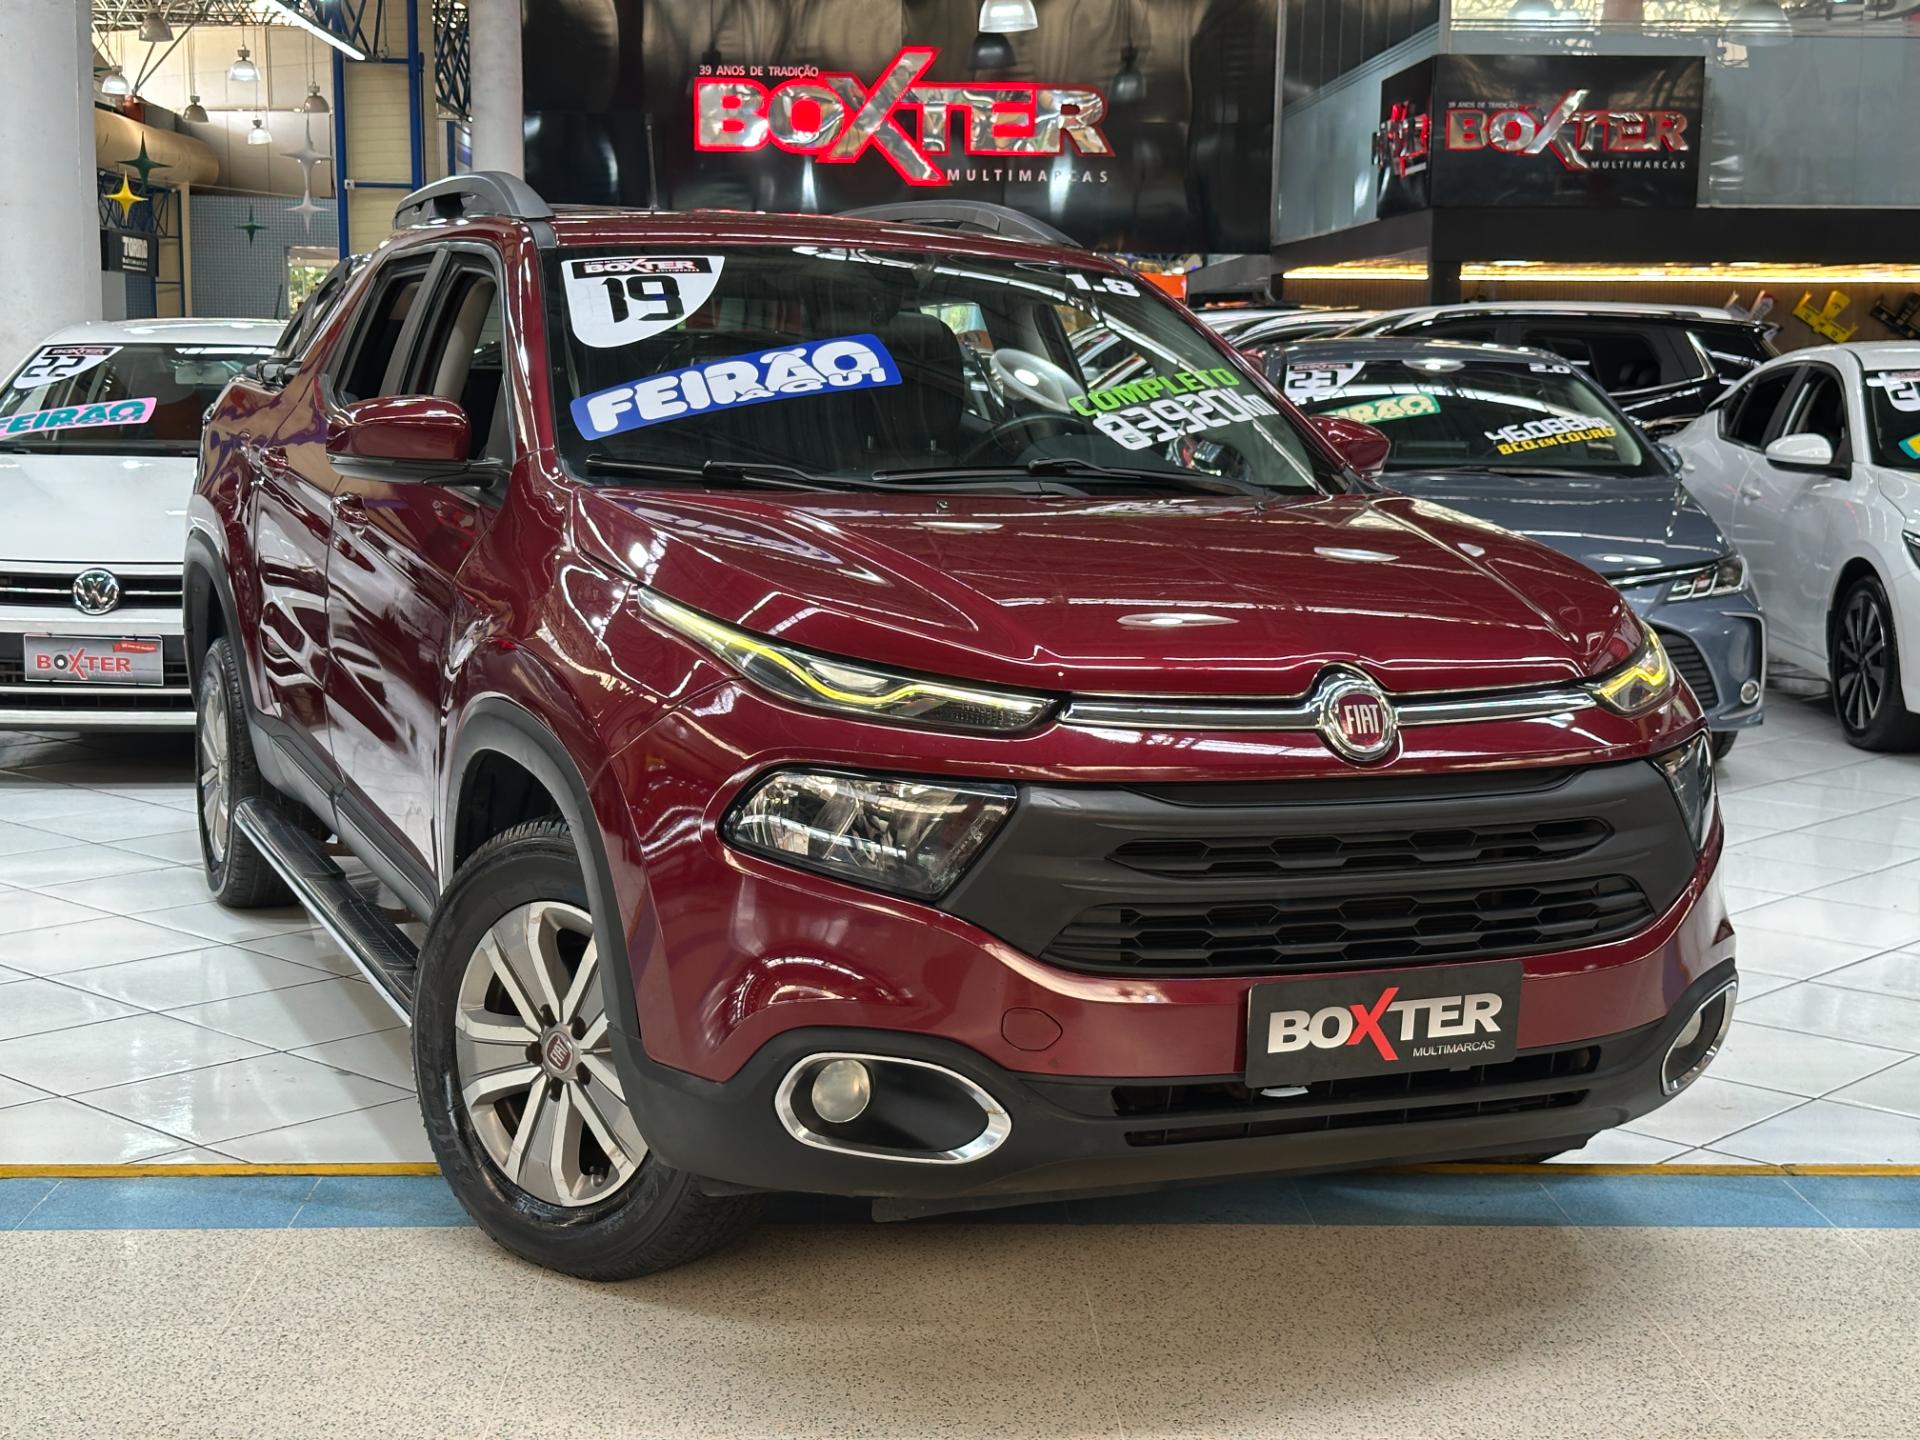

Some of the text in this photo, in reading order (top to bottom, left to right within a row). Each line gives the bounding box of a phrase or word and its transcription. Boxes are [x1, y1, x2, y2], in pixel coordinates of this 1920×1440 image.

[699, 65, 819, 78] 39 ANOS DE TRADIÇÃO
[694, 46, 1116, 186] BOXTER
[1445, 89, 1690, 170] BOXTER
[947, 169, 1109, 183] MULTIMARCAS
[1590, 160, 1686, 169] MULTIMARCAS
[584, 259, 696, 274] BOXTER
[1065, 273, 1140, 297] 1.8
[602, 275, 685, 323] 19
[21, 356, 86, 378] 22
[1528, 362, 1571, 374] 2.0
[586, 340, 881, 433] FEIRÃO
[1288, 370, 1338, 389] 23
[1068, 368, 1240, 416] COMPLETO
[1556, 427, 1617, 444] COURO
[35, 648, 133, 680] BOXTER
[1343, 704, 1380, 735] FIAT
[1267, 987, 1503, 1061] BOXTER
[550, 1038, 569, 1067] FIAT
[1412, 1040, 1496, 1058] MULTIMARCAS
